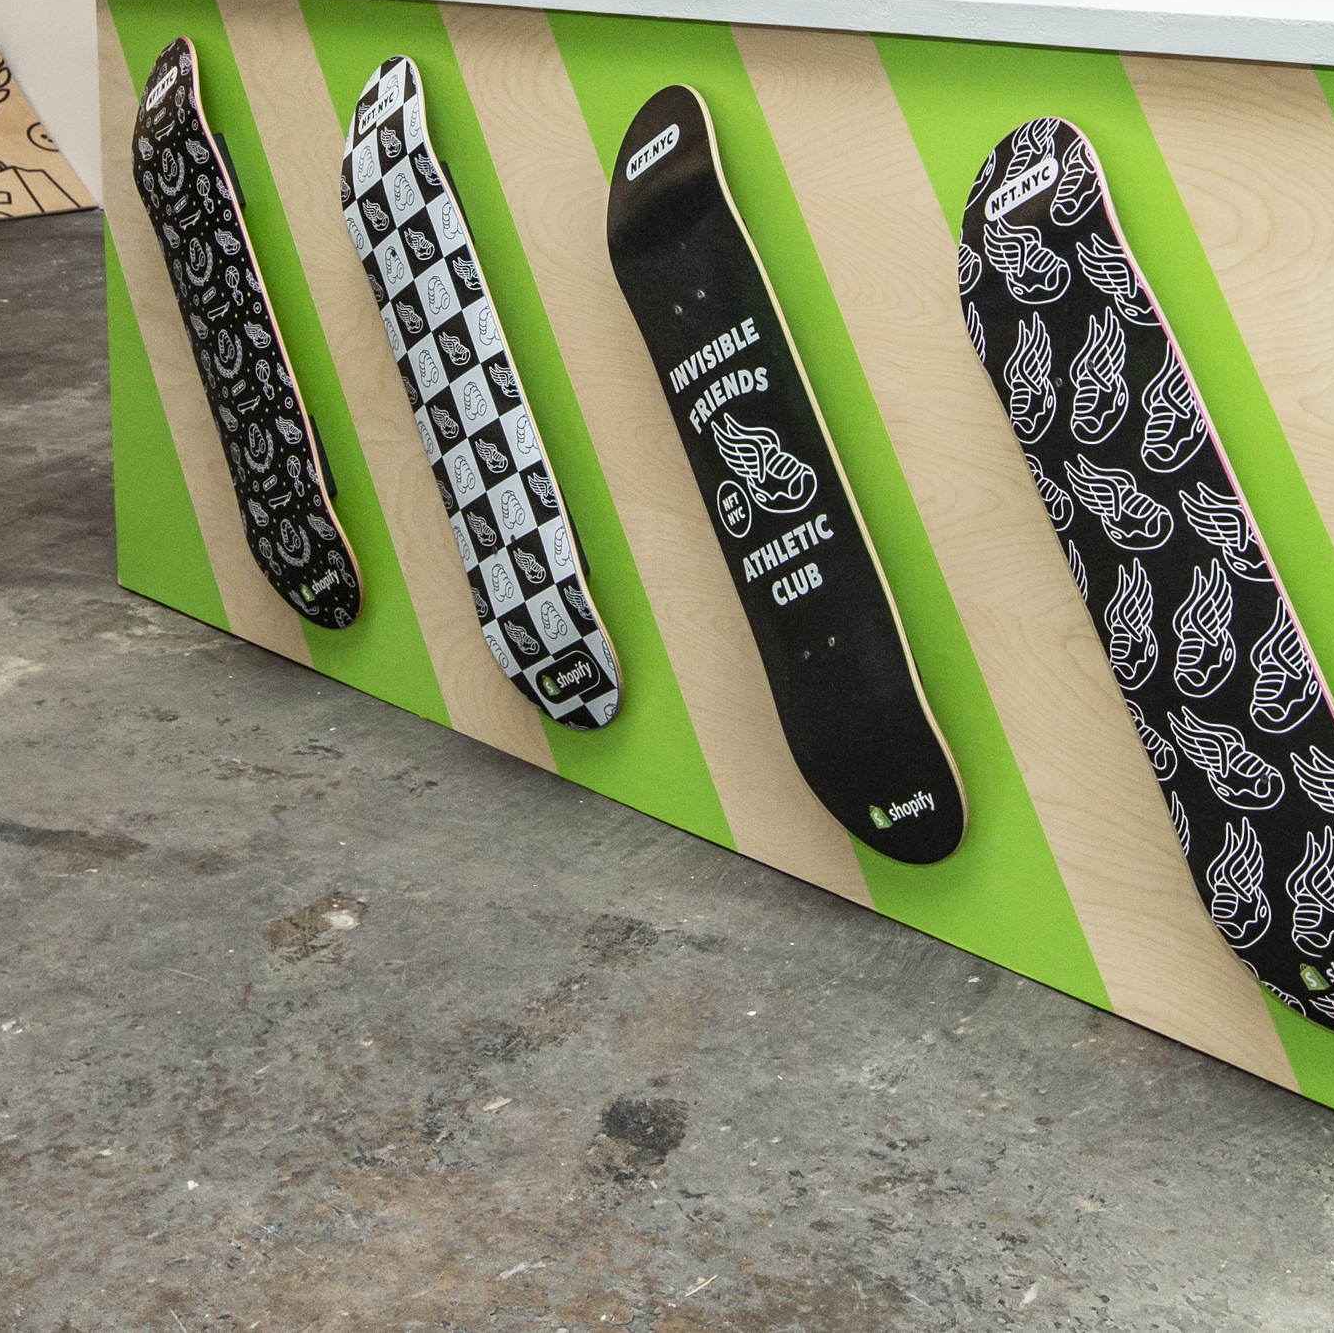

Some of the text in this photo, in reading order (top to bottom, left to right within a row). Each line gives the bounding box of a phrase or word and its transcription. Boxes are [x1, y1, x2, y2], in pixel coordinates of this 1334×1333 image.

[361, 91, 394, 129] NFT.NYC
[630, 131, 674, 174] NFT.NYC
[990, 167, 1051, 215] NFT.NYC
[670, 317, 760, 394] INVISIBLE
[689, 366, 769, 435] FRIENDS
[722, 492, 739, 511] NFT
[728, 506, 746, 526] NYC
[742, 513, 835, 583] ATHLETIC
[311, 568, 340, 595] shopify
[772, 562, 823, 606] CLUB
[556, 660, 593, 689] shopify
[888, 790, 935, 822] shopify
